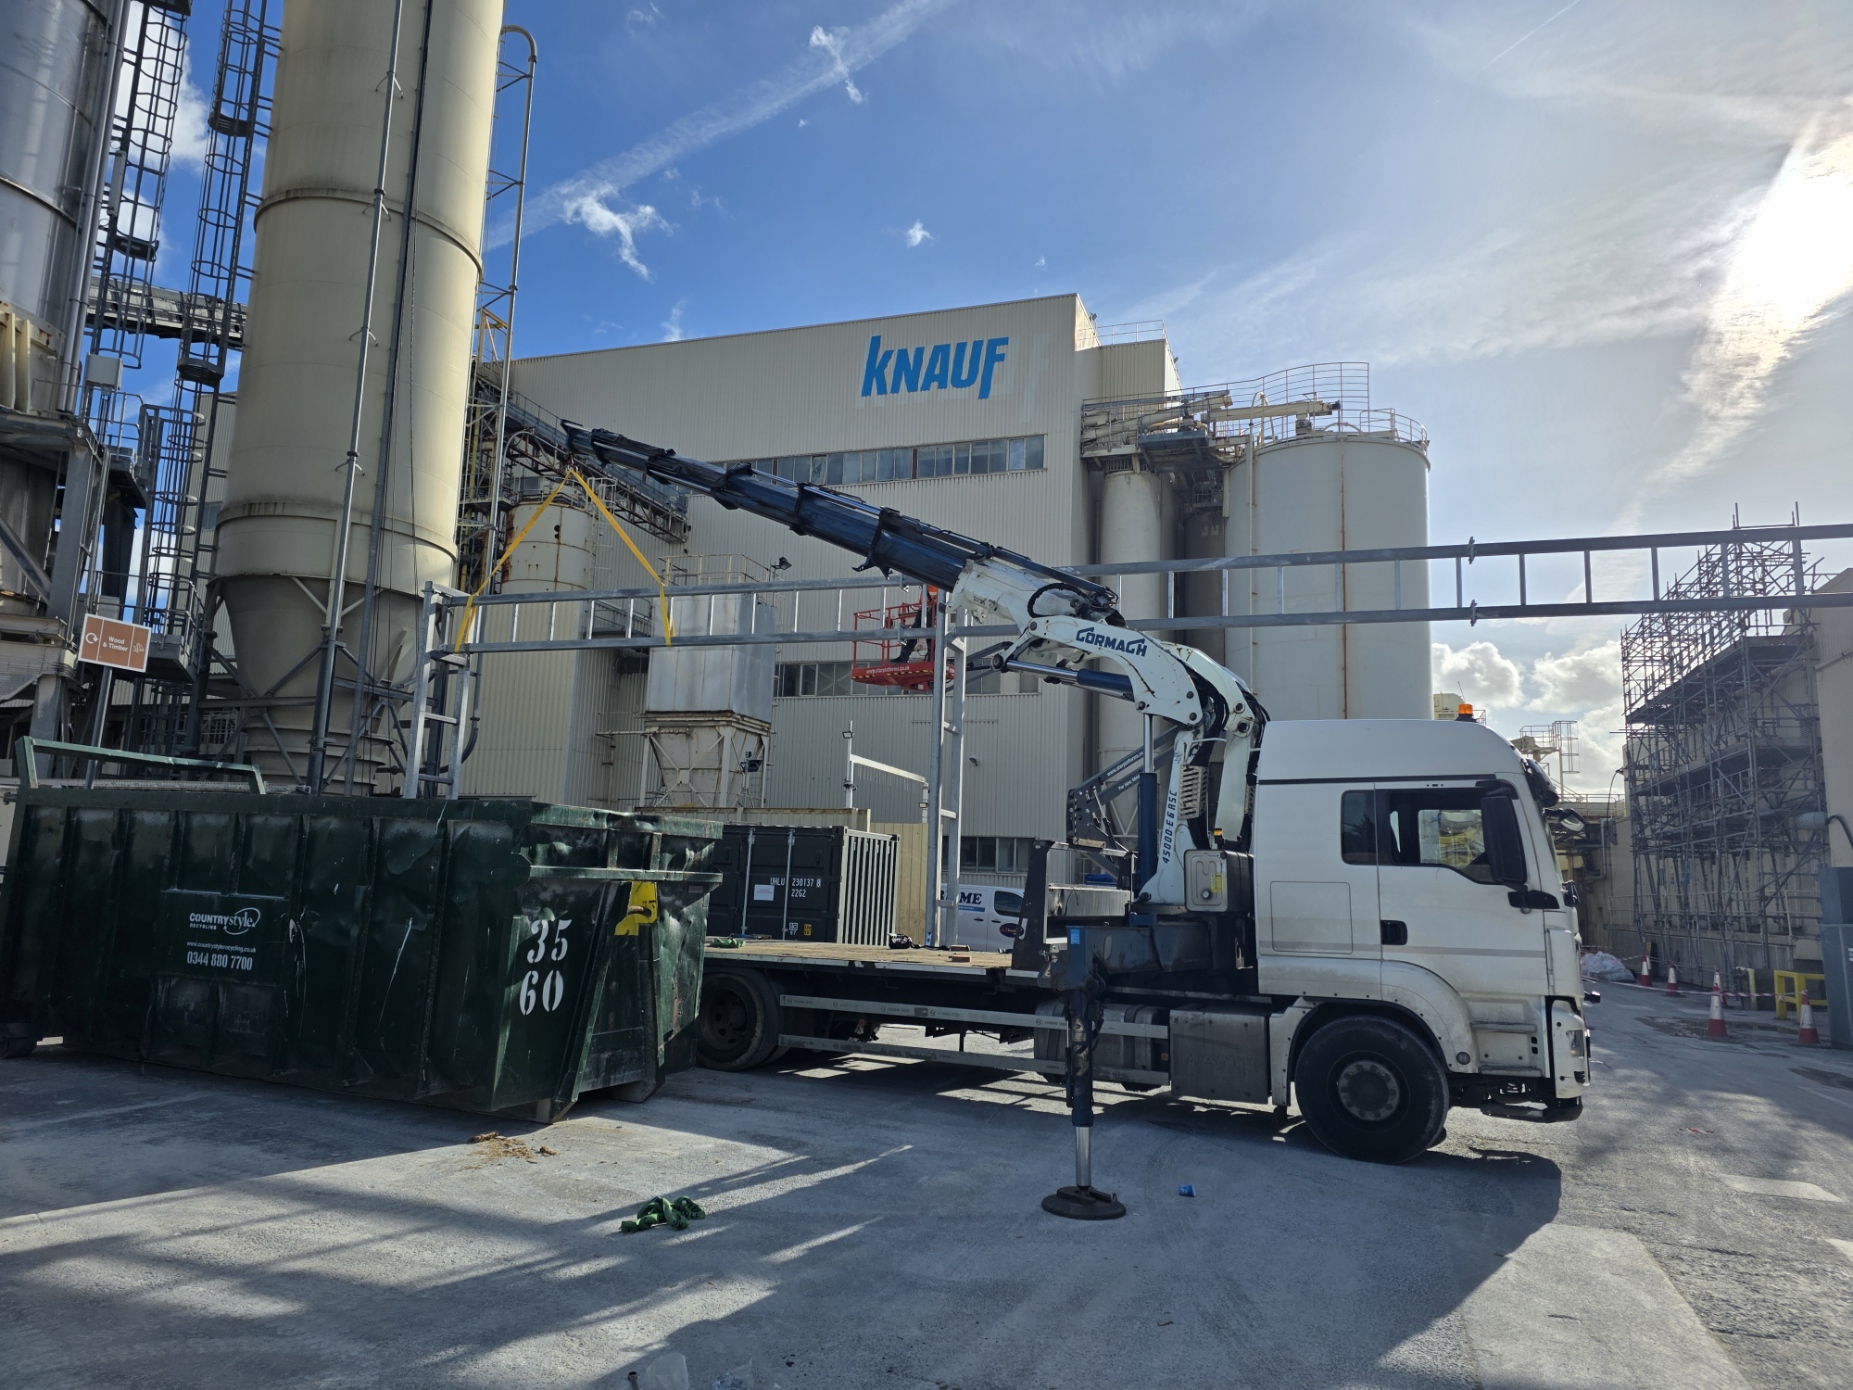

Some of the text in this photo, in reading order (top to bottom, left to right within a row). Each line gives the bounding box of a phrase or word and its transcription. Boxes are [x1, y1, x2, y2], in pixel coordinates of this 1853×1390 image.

[108, 636, 124, 644] Wood
[108, 642, 128, 652] Timber
[792, 878, 814, 887] 230137
[791, 889, 806, 898] 22G2
[526, 919, 573, 964] 35
[186, 951, 253, 971] 0344 880 7700
[519, 969, 564, 1016] 60
